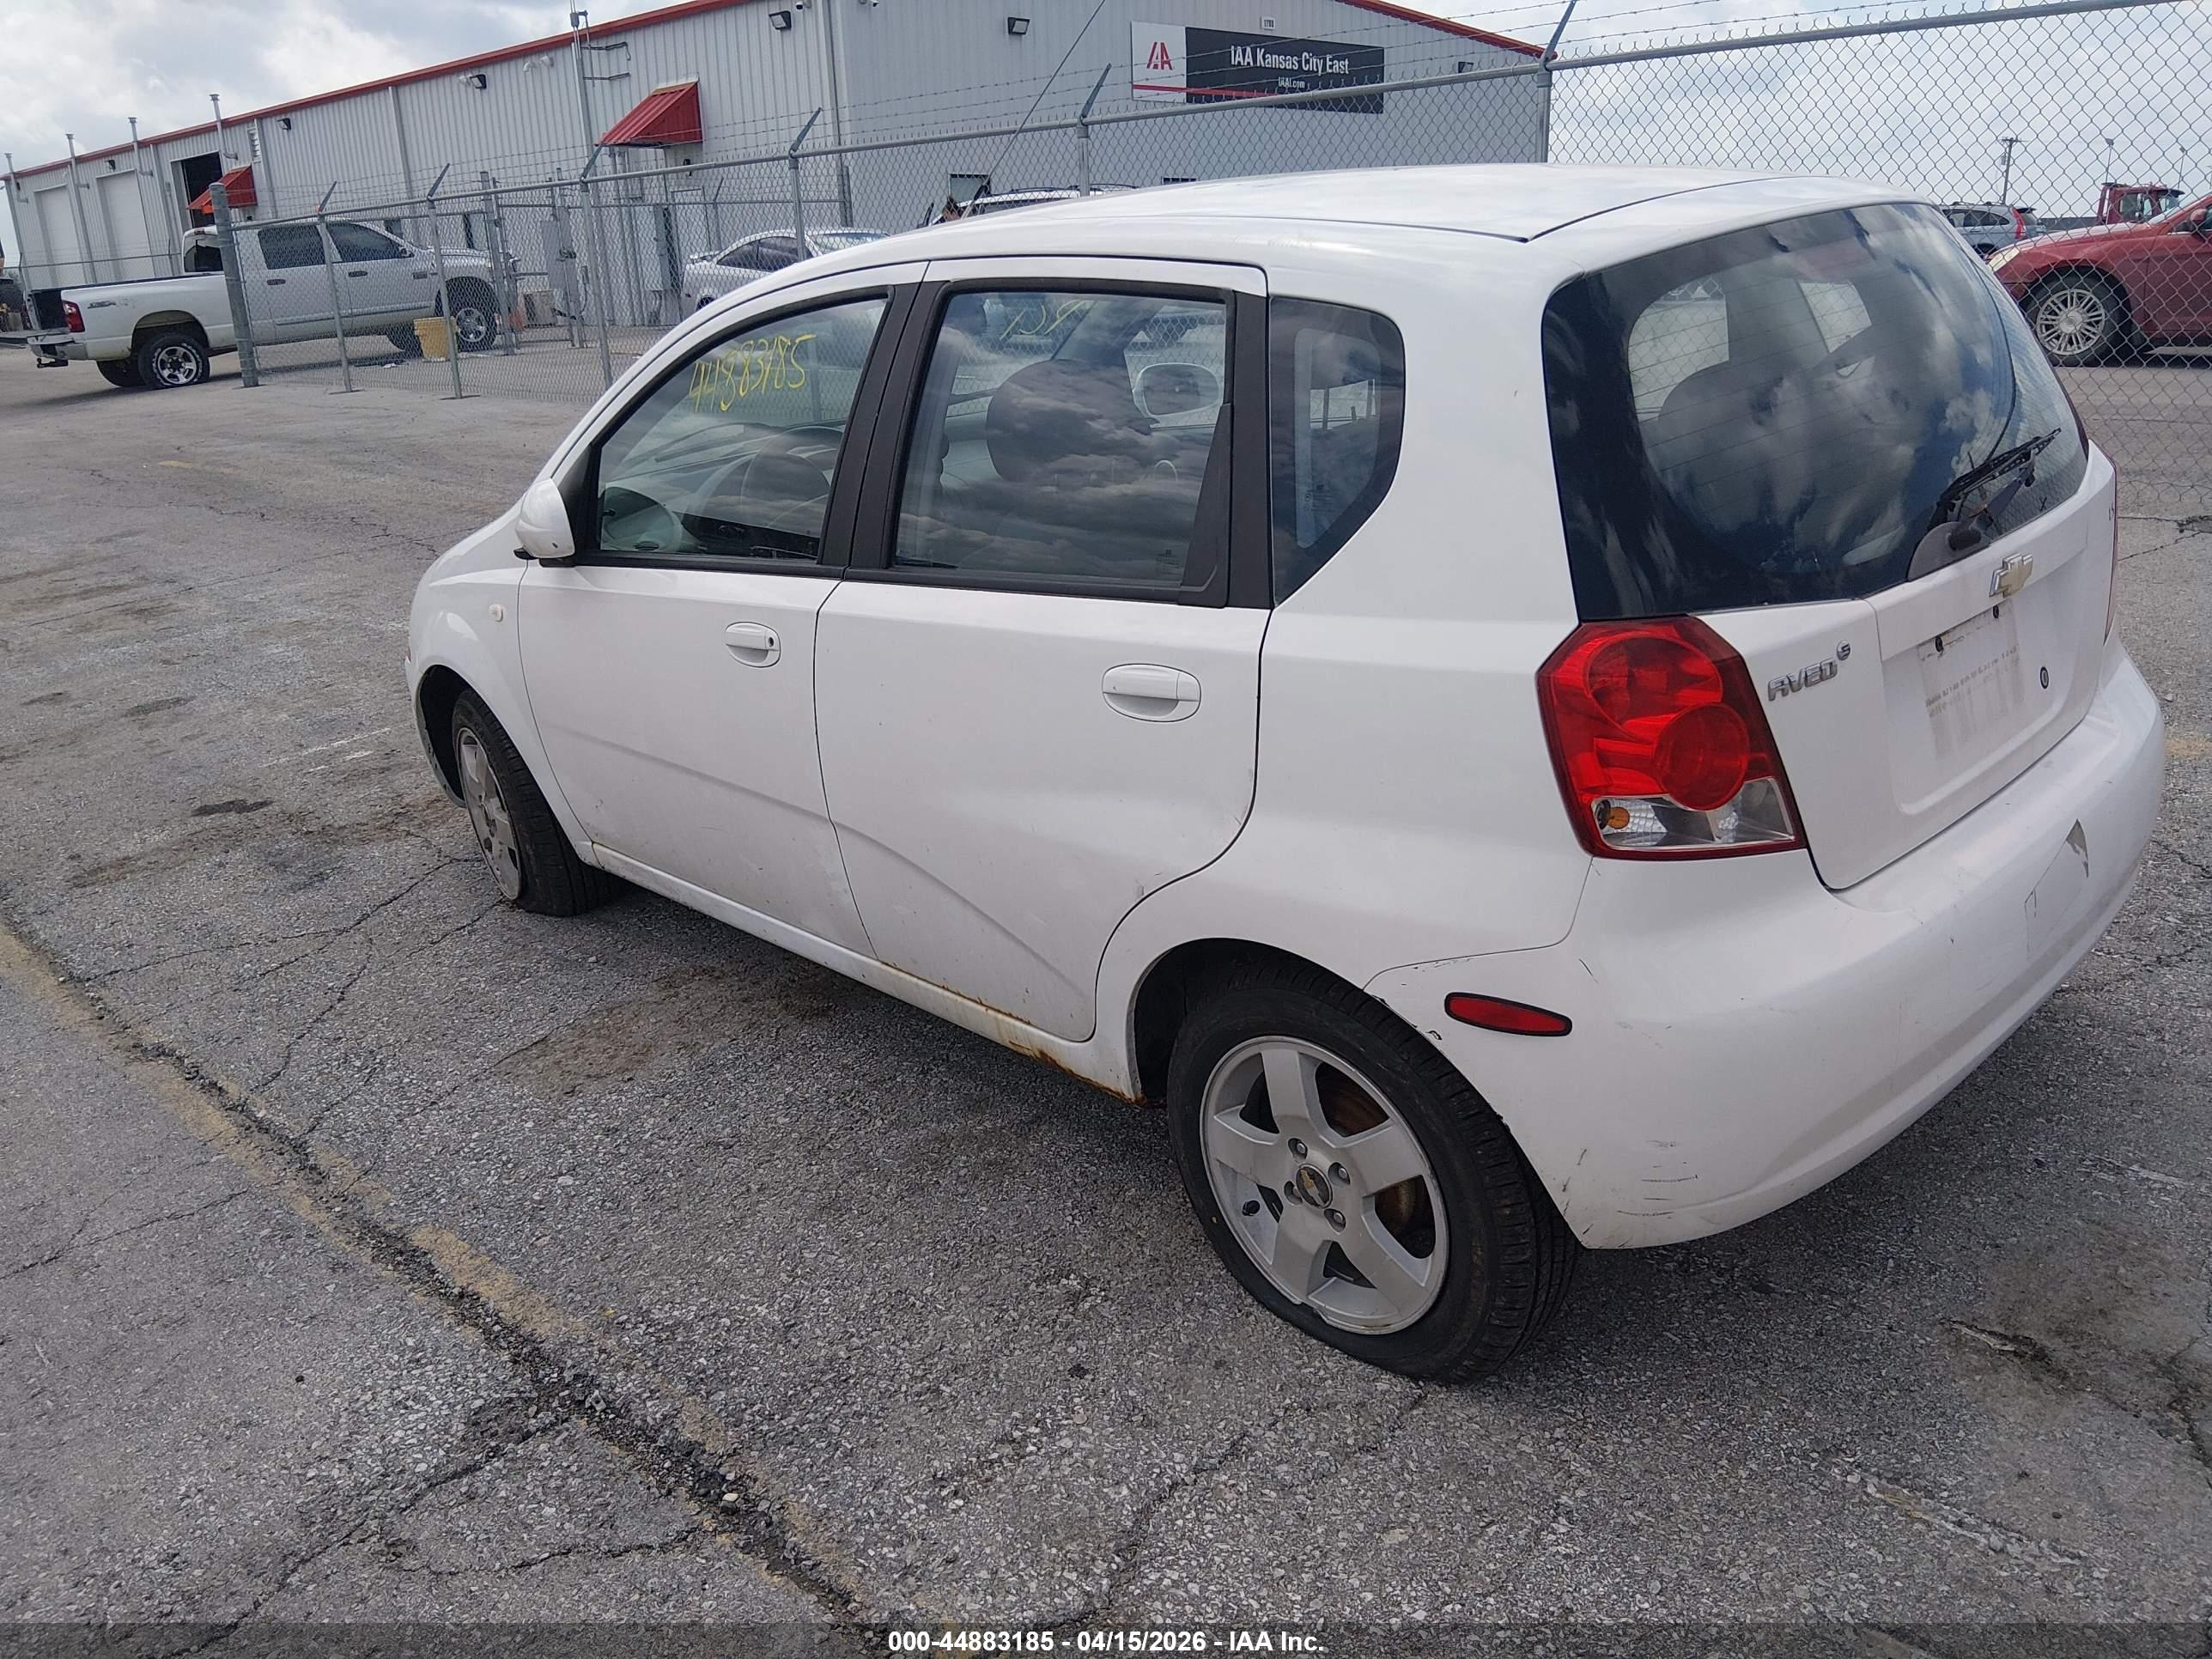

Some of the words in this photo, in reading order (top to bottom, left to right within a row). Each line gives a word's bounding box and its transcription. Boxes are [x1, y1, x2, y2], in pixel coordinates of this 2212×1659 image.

[1231, 45, 1254, 67] IAA
[1256, 47, 1299, 70] Kansas
[1302, 52, 1323, 76] City
[1326, 55, 1349, 75] East
